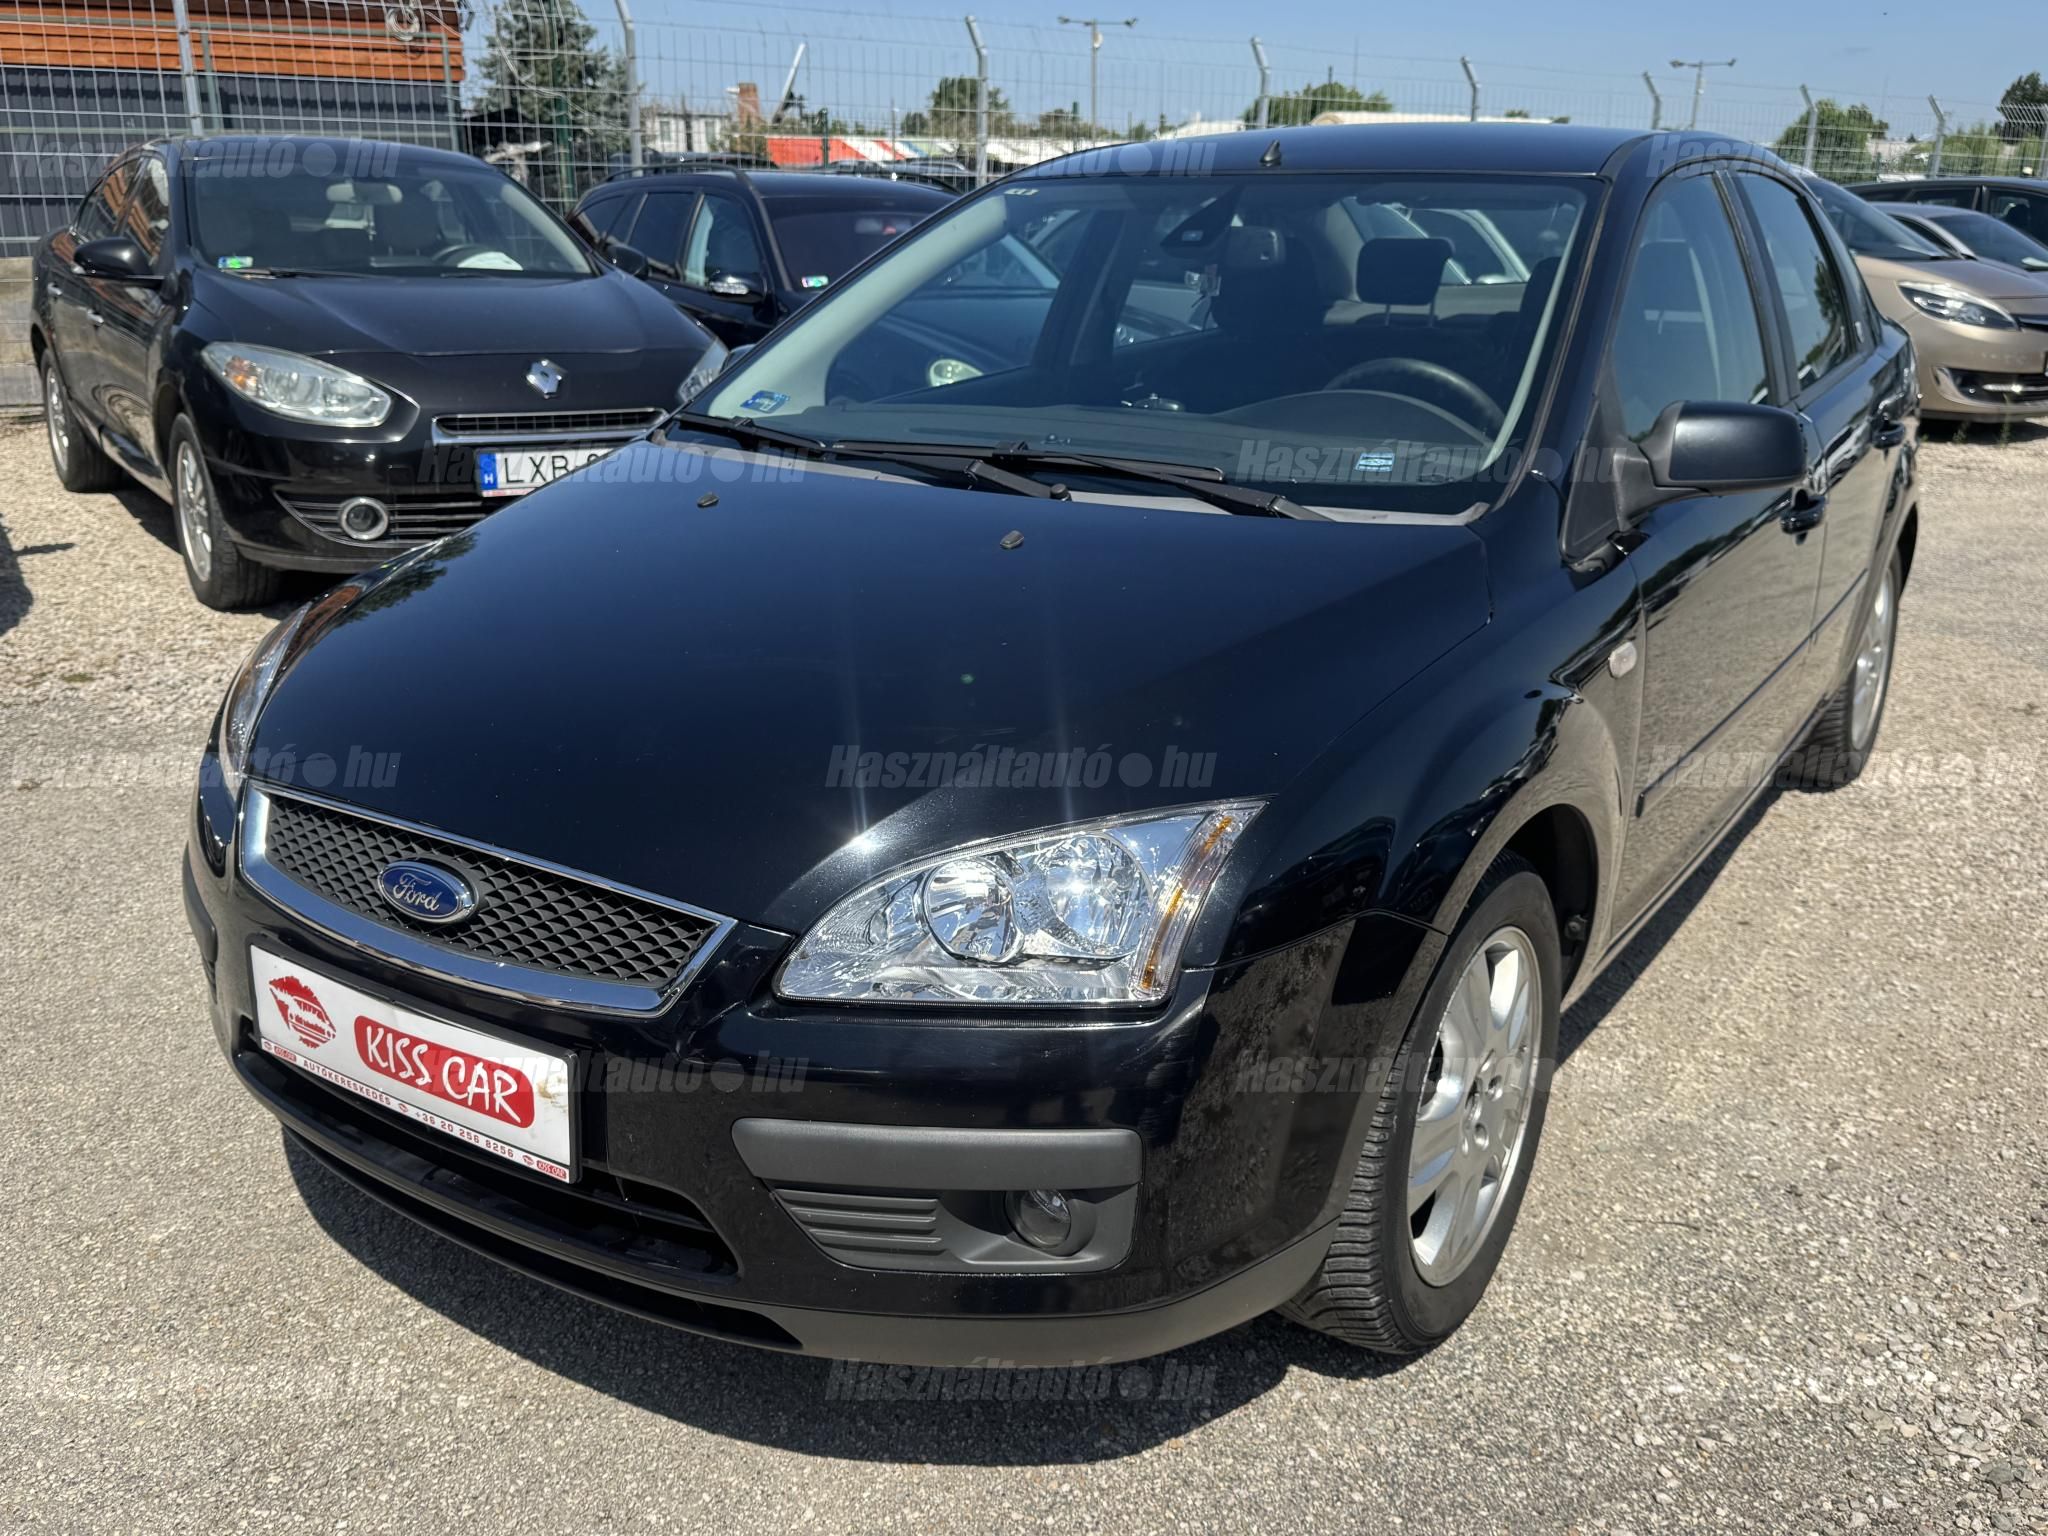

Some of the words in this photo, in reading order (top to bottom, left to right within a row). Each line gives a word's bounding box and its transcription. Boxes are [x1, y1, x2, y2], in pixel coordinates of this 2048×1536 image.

[393, 872, 442, 911] Ford
[366, 1025, 432, 1086] KISS
[442, 1056, 521, 1123] CAR
[441, 1120, 454, 1134] 20
[459, 1129, 480, 1144] 256
[485, 1139, 514, 1159] 8256
